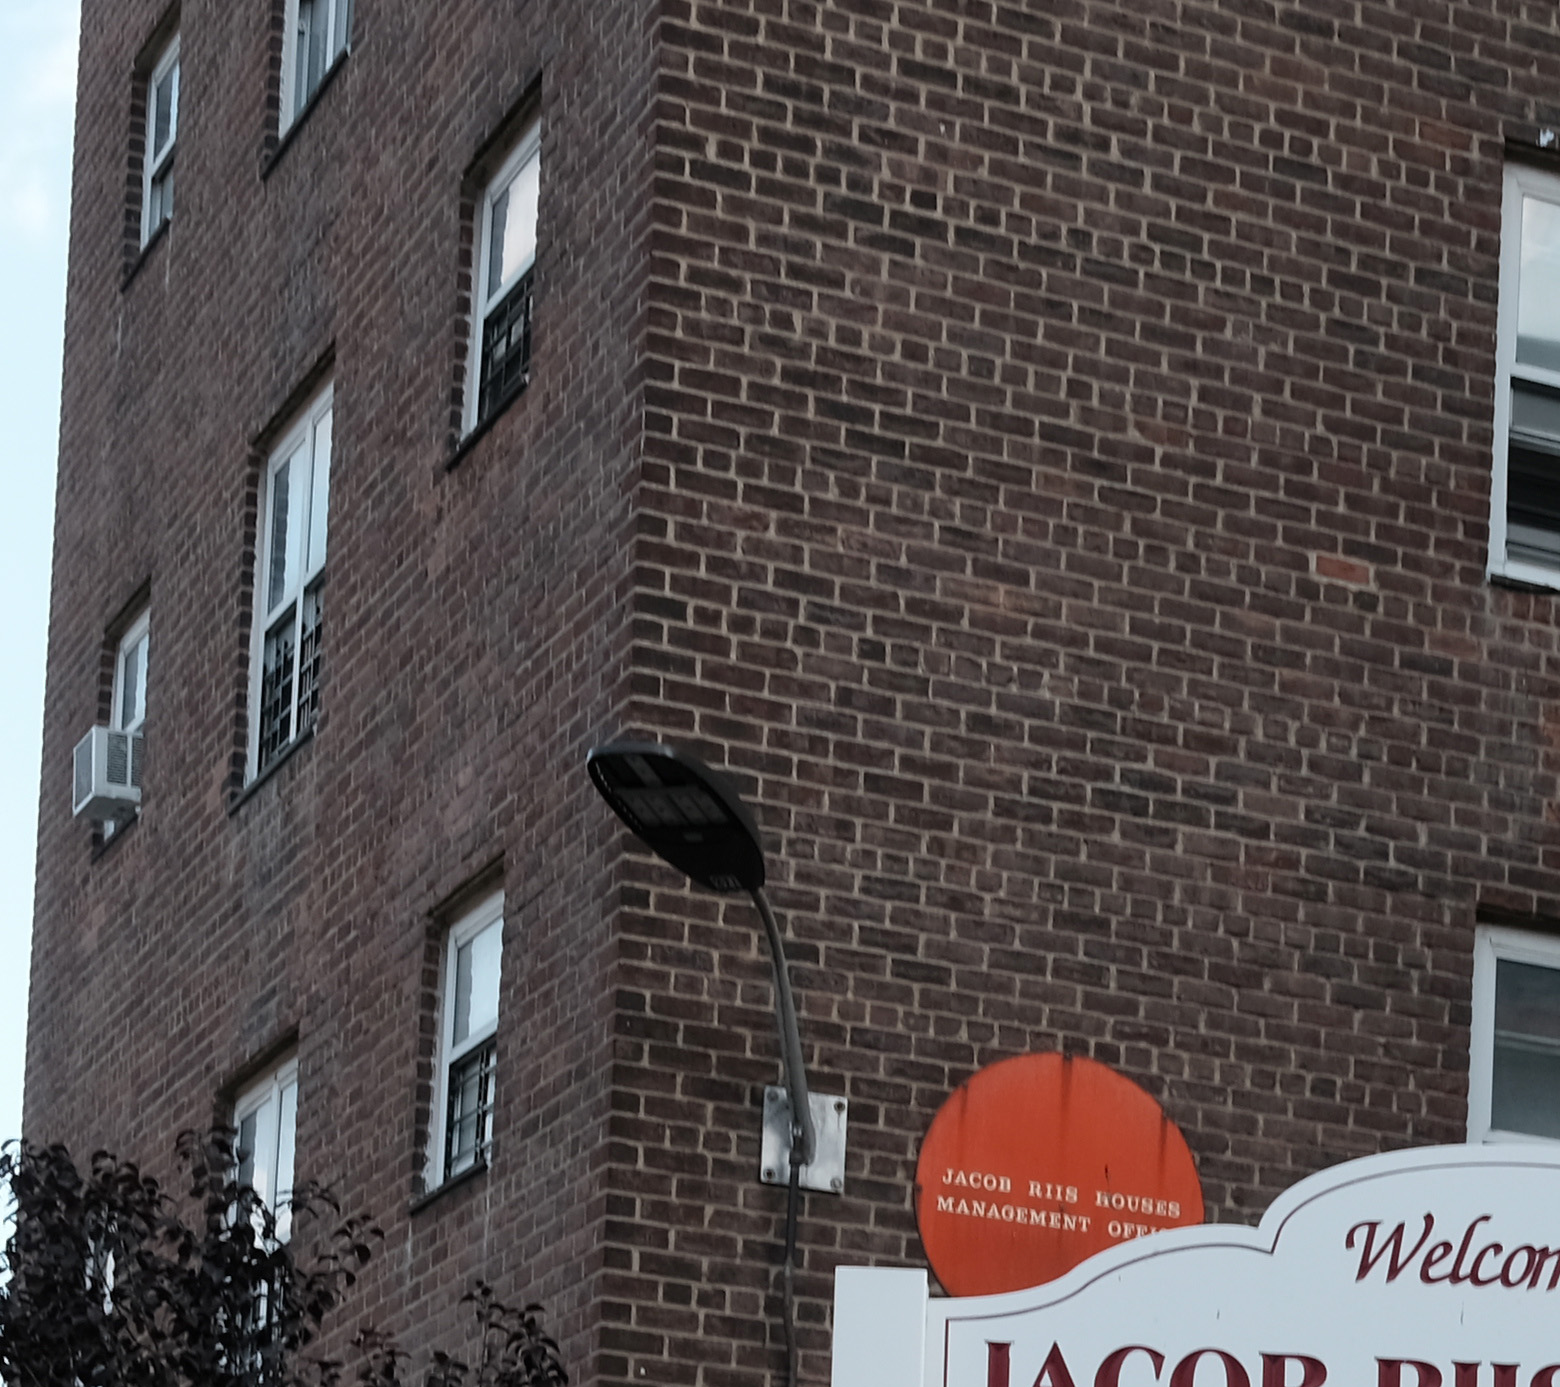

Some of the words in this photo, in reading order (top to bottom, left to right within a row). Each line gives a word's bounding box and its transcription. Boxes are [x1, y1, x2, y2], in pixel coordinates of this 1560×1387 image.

[942, 1168, 1012, 1193] JACOB
[1028, 1180, 1079, 1204] RIIS
[1094, 1190, 1181, 1218] HOUSES
[936, 1195, 1091, 1232] MANAGEMENT
[1108, 1220, 1168, 1239] OFF
